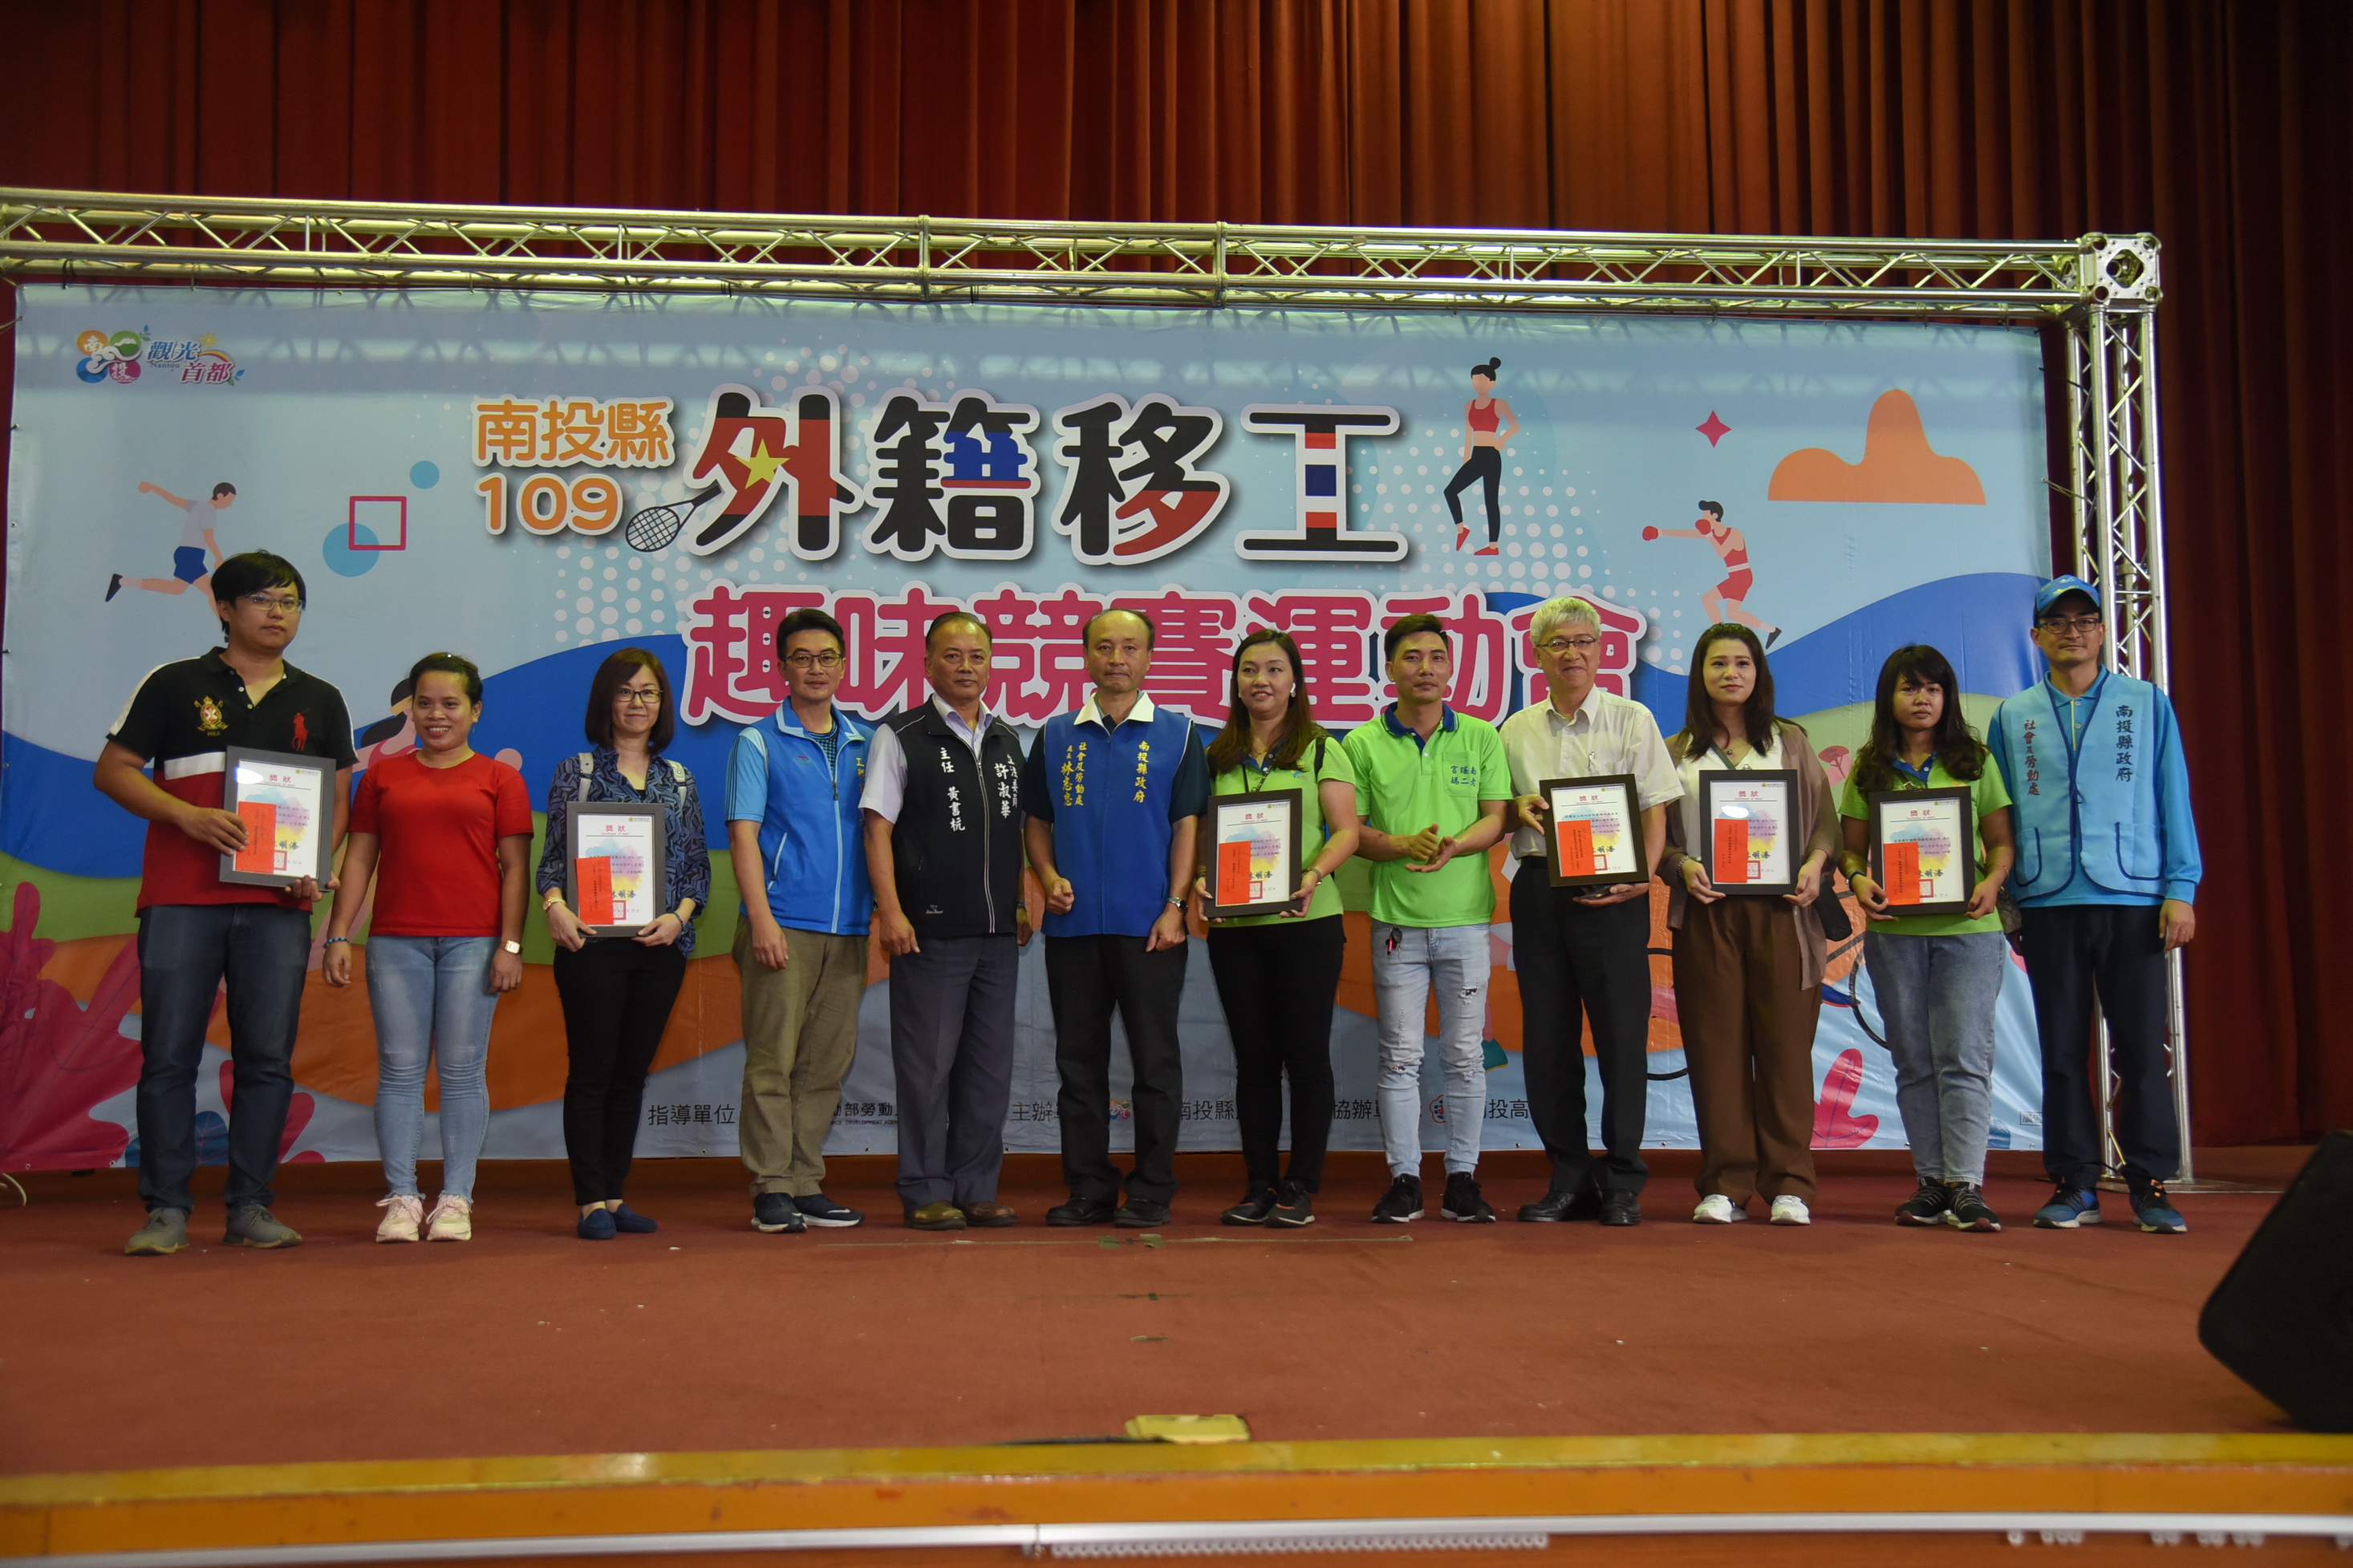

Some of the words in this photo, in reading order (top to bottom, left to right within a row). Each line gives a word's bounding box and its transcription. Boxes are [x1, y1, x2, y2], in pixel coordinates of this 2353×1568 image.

[83, 335, 103, 352] 南
[147, 341, 200, 361] 觀光
[181, 362, 233, 383] 首都
[477, 399, 669, 463] 南投縣
[692, 391, 1400, 556] 外籍移工
[475, 475, 622, 533] 109
[2116, 704, 2135, 783] 南投縣政府
[939, 746, 955, 773] 主任
[2022, 719, 2041, 796] 社會及勞動處
[1074, 741, 1088, 806] 社會及勞動處
[1133, 739, 1150, 804] 南投縣政府
[993, 762, 1012, 819] 許淑華
[647, 1103, 736, 1126] 指導單位
[833, 1101, 898, 1117] 部勞動
[1011, 1100, 1060, 1122] 主辦
[1180, 1100, 1239, 1120] 南投縣
[1484, 1098, 1528, 1120] 投高
